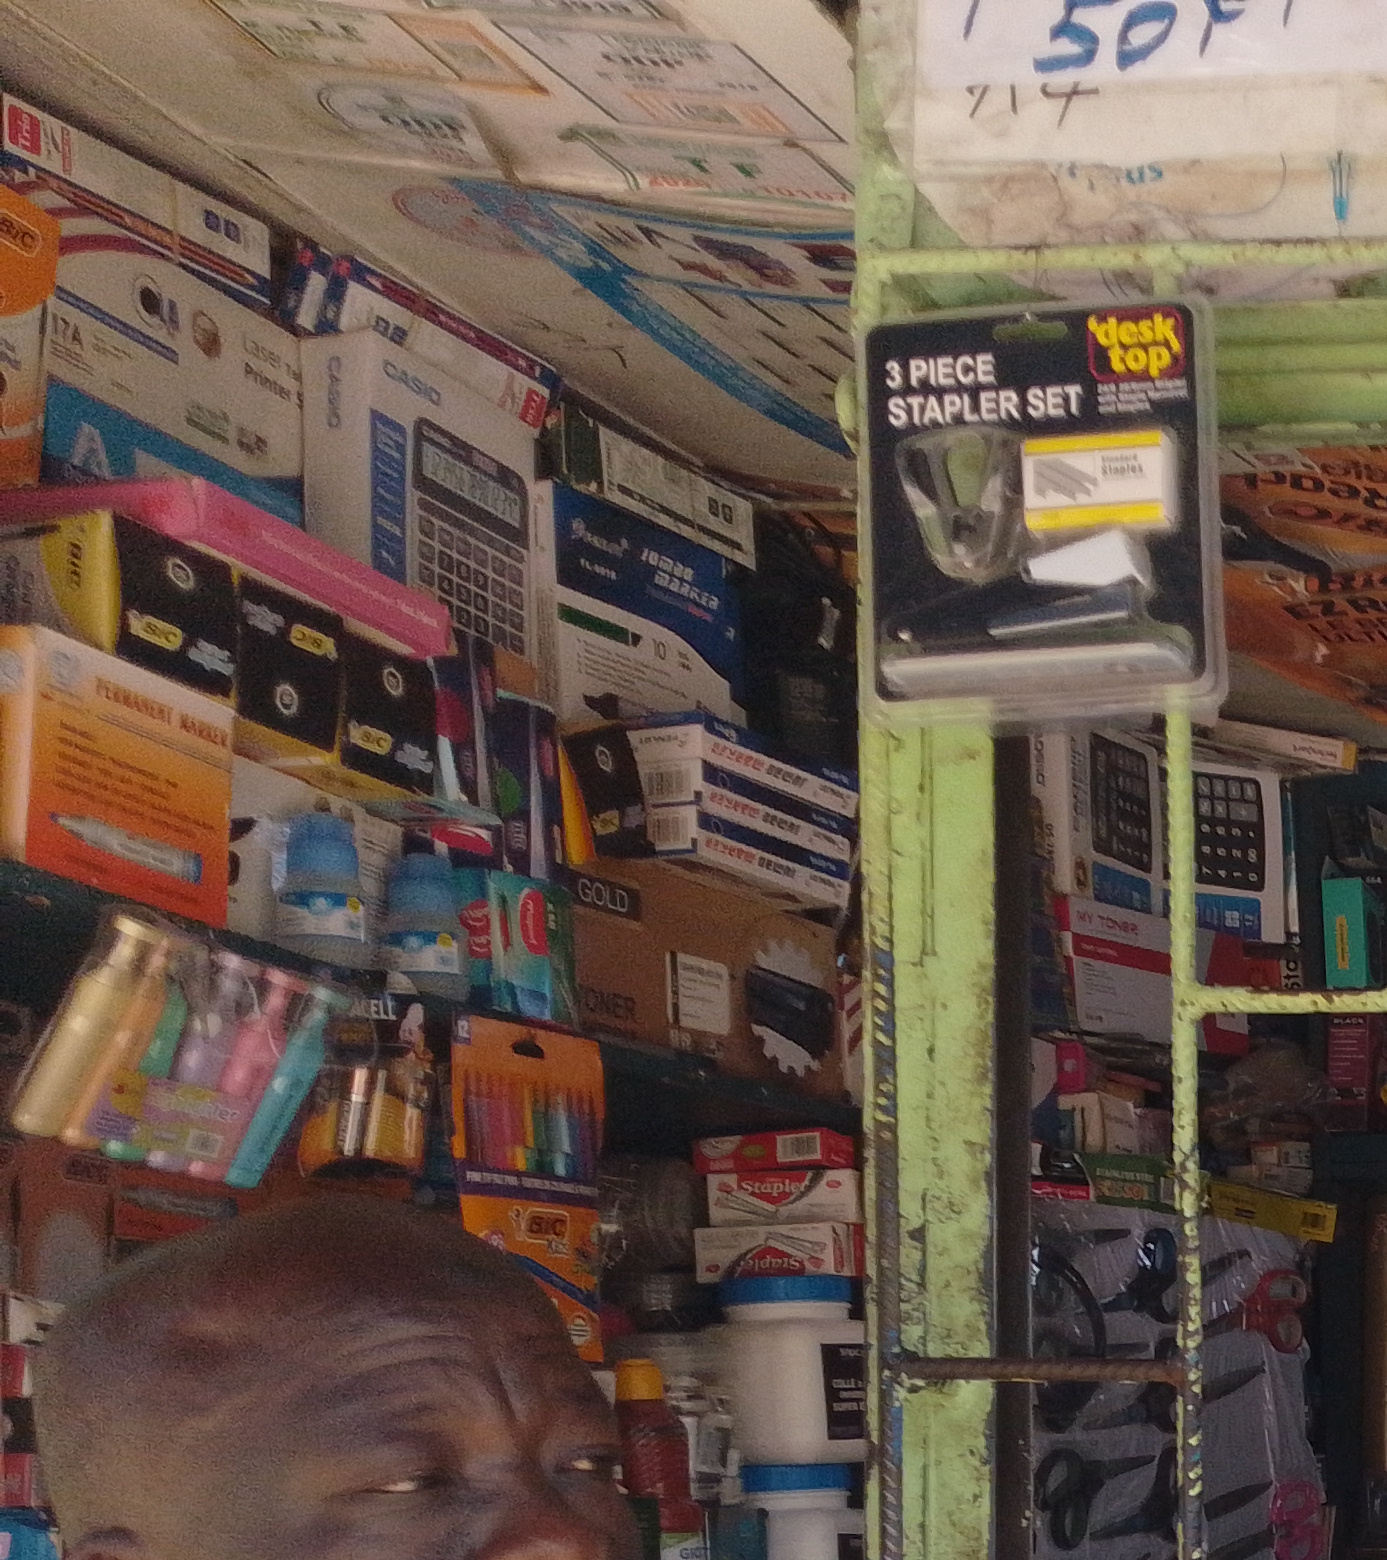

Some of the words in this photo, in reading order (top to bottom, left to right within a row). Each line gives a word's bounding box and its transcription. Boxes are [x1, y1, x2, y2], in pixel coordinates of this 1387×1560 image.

[1086, 313, 1182, 353] desk
[885, 360, 903, 391] 3
[909, 352, 998, 388] PIECE
[1107, 346, 1172, 378] top
[381, 359, 442, 406] CASIO
[887, 387, 1023, 430] STAPLER
[1026, 383, 1084, 419] SET
[1101, 464, 1144, 477] Staples
[578, 879, 628, 912] GOLD
[1332, 1016, 1365, 1026] BLACK
[528, 1217, 567, 1238] BIC
